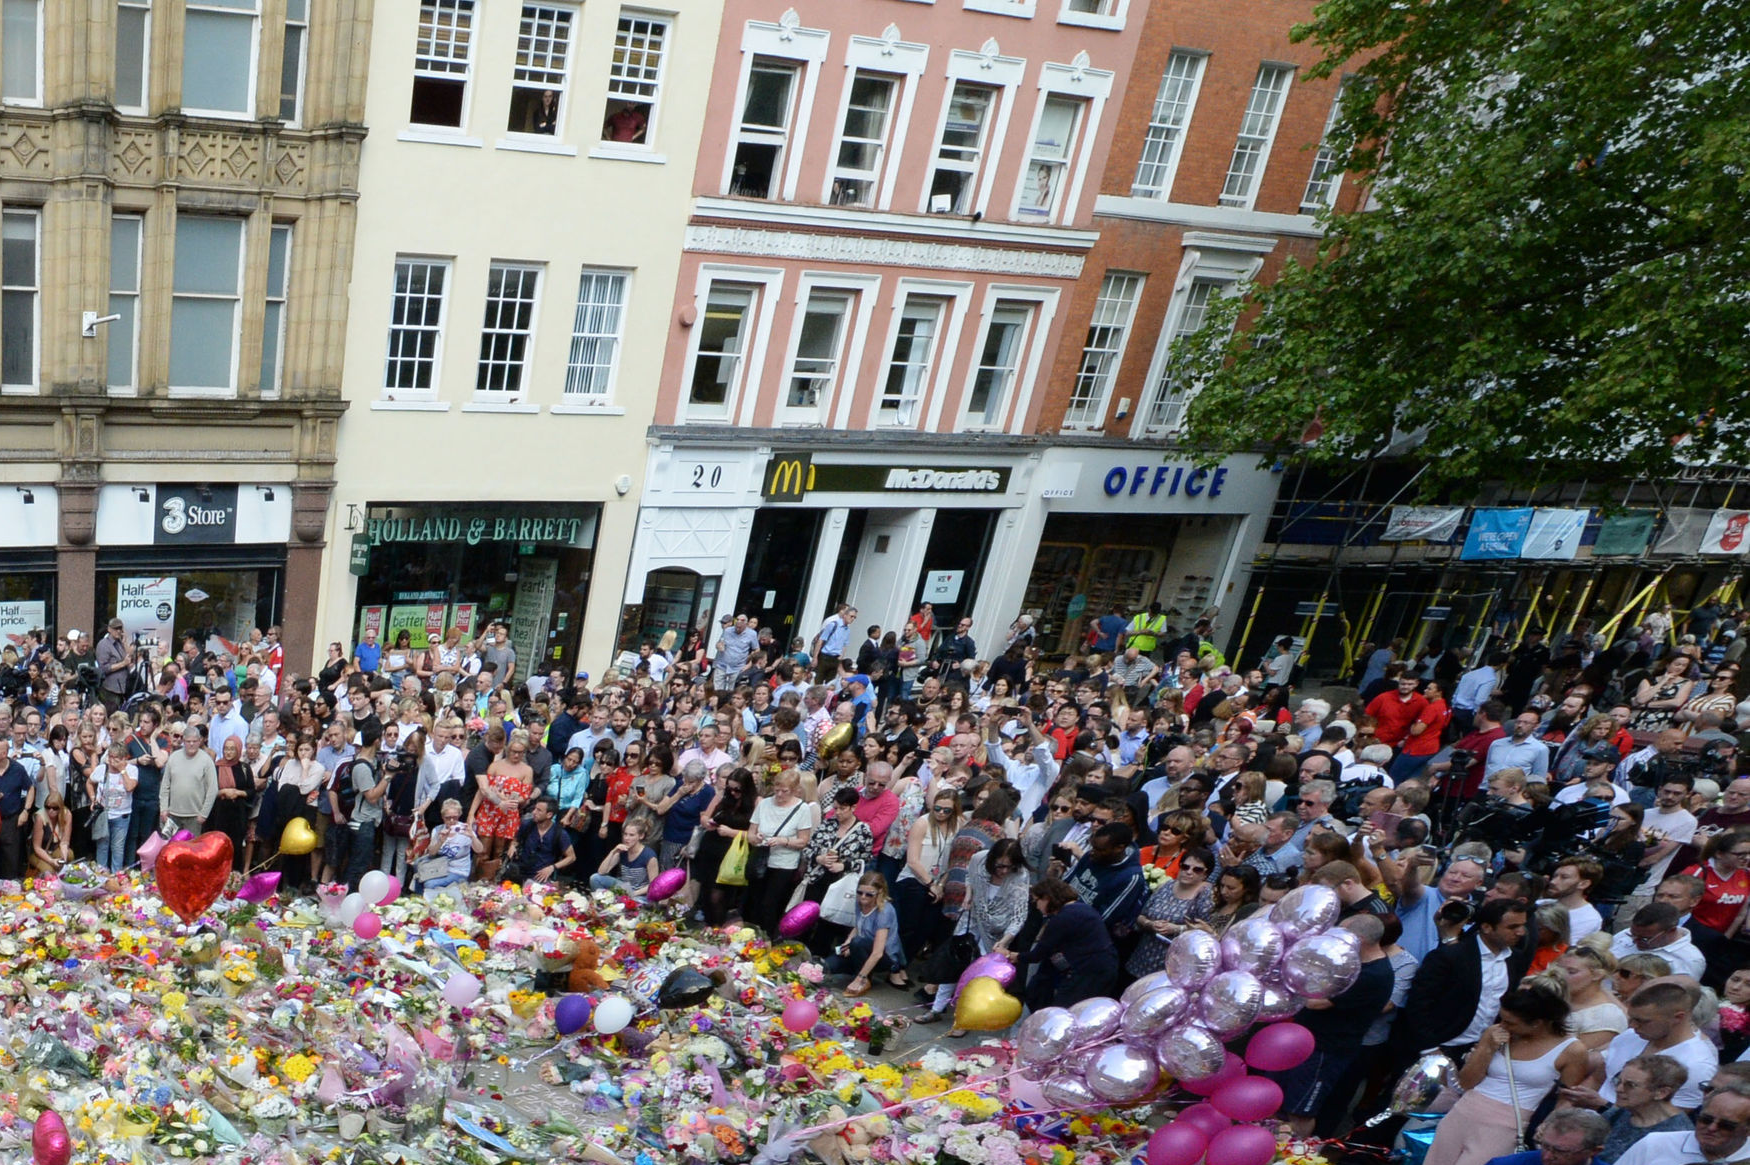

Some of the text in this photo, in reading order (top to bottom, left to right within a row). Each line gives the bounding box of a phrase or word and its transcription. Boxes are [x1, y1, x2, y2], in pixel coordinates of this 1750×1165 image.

[884, 469, 1001, 490] McDonald's
[1104, 466, 1228, 497] OFFICE
[161, 496, 225, 535] 3 Store
[367, 517, 581, 546] HOLLAND & BARRETT
[121, 584, 145, 597] Half
[0, 606, 20, 615] Half
[121, 597, 153, 611] price.
[392, 615, 425, 627] better
